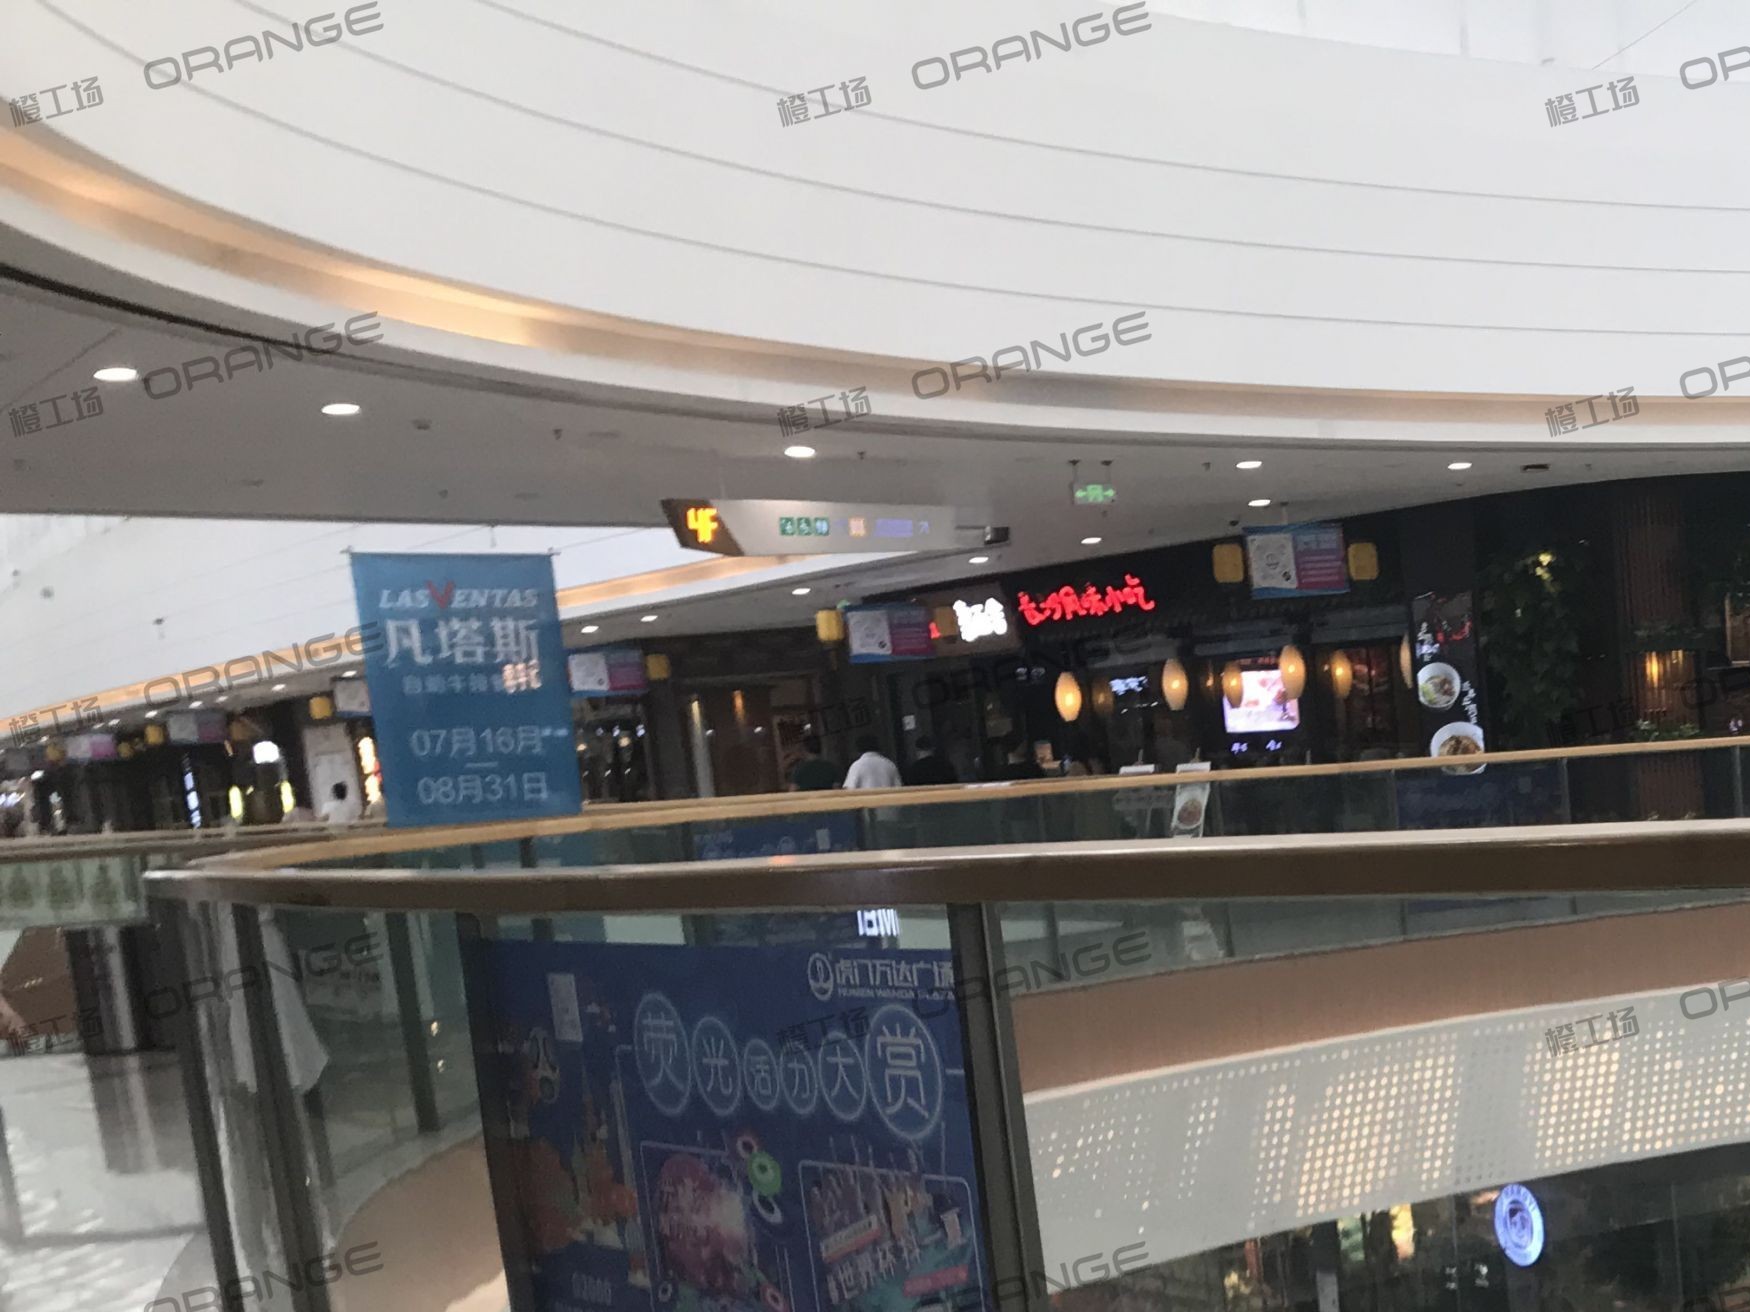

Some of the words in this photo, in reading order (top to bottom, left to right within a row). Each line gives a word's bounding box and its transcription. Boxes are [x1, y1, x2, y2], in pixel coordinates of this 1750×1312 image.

[686, 506, 719, 544] 4F
[385, 616, 542, 669] 凡塔斯
[416, 770, 550, 805] 08月31日
[836, 958, 955, 988] 虎门万达广场
